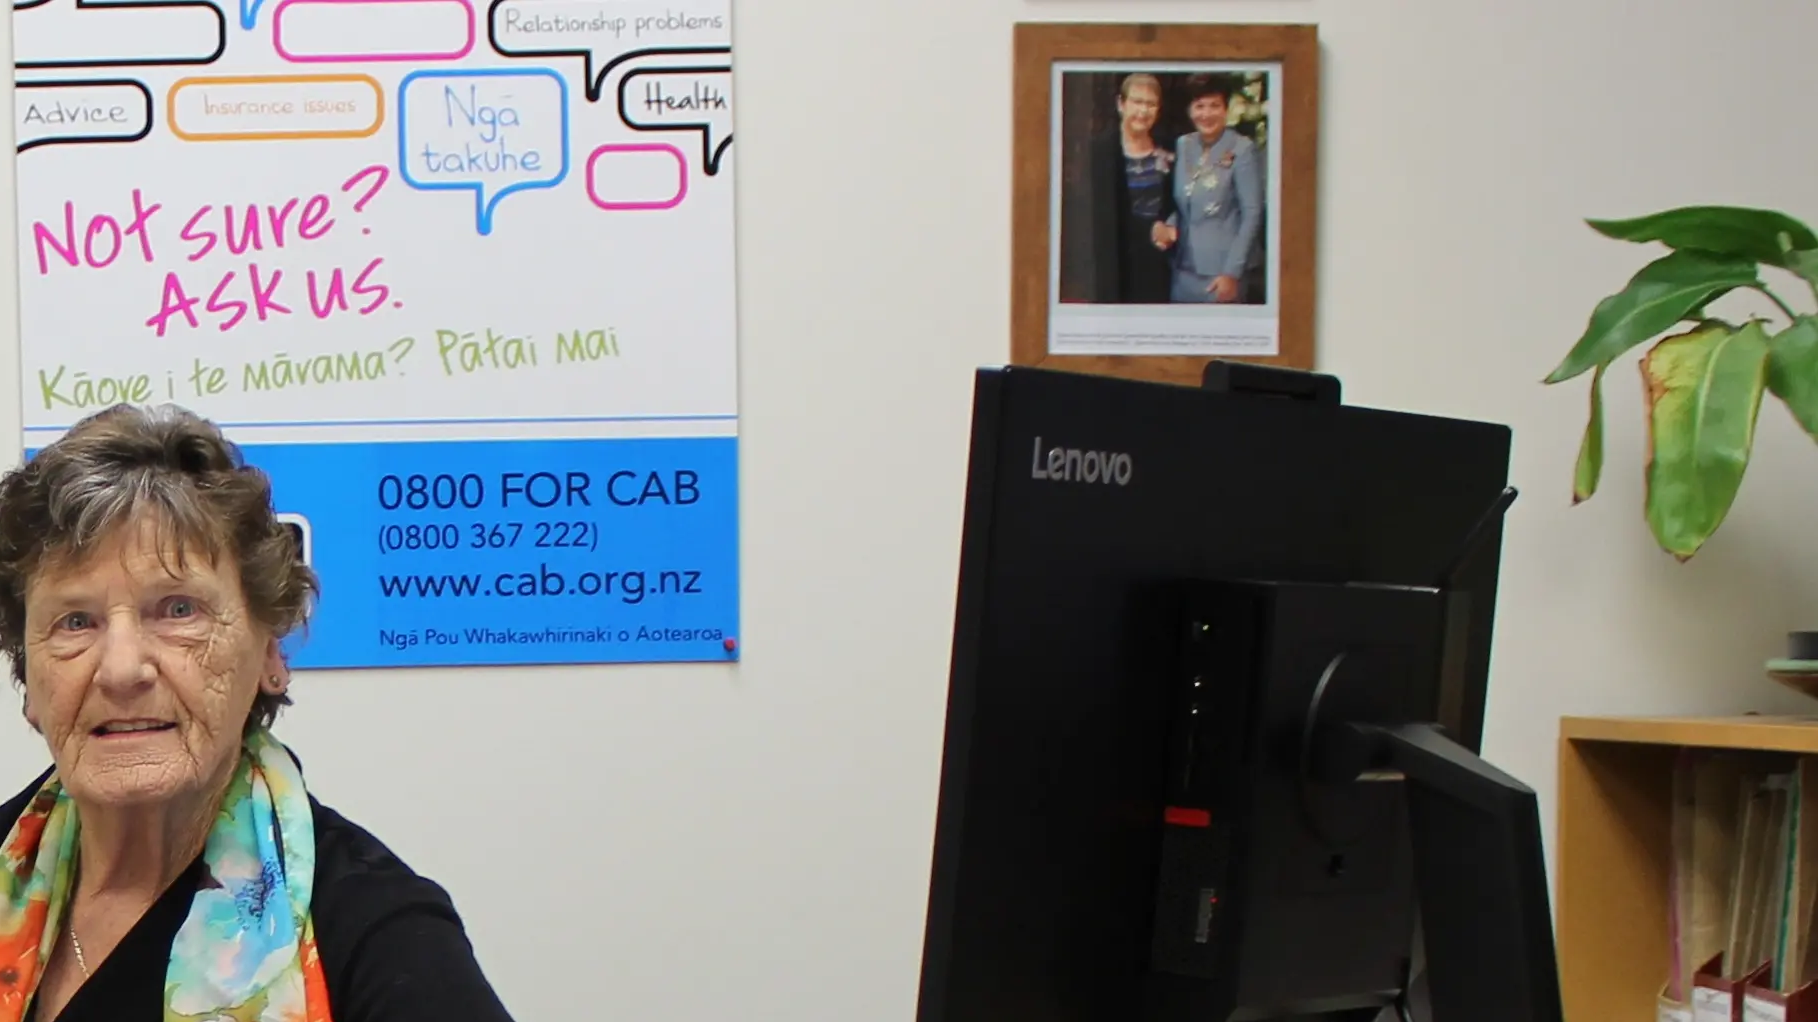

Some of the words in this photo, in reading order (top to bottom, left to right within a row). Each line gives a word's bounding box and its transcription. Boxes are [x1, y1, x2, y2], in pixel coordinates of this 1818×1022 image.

[506, 9, 626, 38] Relationship
[635, 10, 722, 38] problems
[24, 102, 127, 123] Advice
[204, 94, 293, 115] Insurance
[304, 100, 356, 114] issues
[444, 84, 520, 144] Ngā
[645, 82, 726, 114] Health
[421, 136, 541, 173] takuhe
[33, 188, 162, 274] Not
[179, 165, 390, 263] sure?
[307, 258, 404, 319] us.
[167, 371, 174, 399] i
[189, 359, 227, 396] te
[438, 329, 537, 377] Pātai
[1032, 438, 1132, 486] Lenovo
[379, 474, 483, 510] 0800
[502, 472, 590, 508] FOR
[607, 470, 700, 506] CAB
[379, 524, 459, 554] (0800
[471, 523, 523, 548] 367
[535, 522, 597, 552] 222)
[379, 563, 702, 603] www.cab.org.nz
[380, 630, 418, 650] Ngā
[425, 629, 458, 644] Pou
[464, 627, 611, 644] Whakawhirinaki
[618, 631, 629, 642] o
[636, 626, 723, 645] Aotearoa
